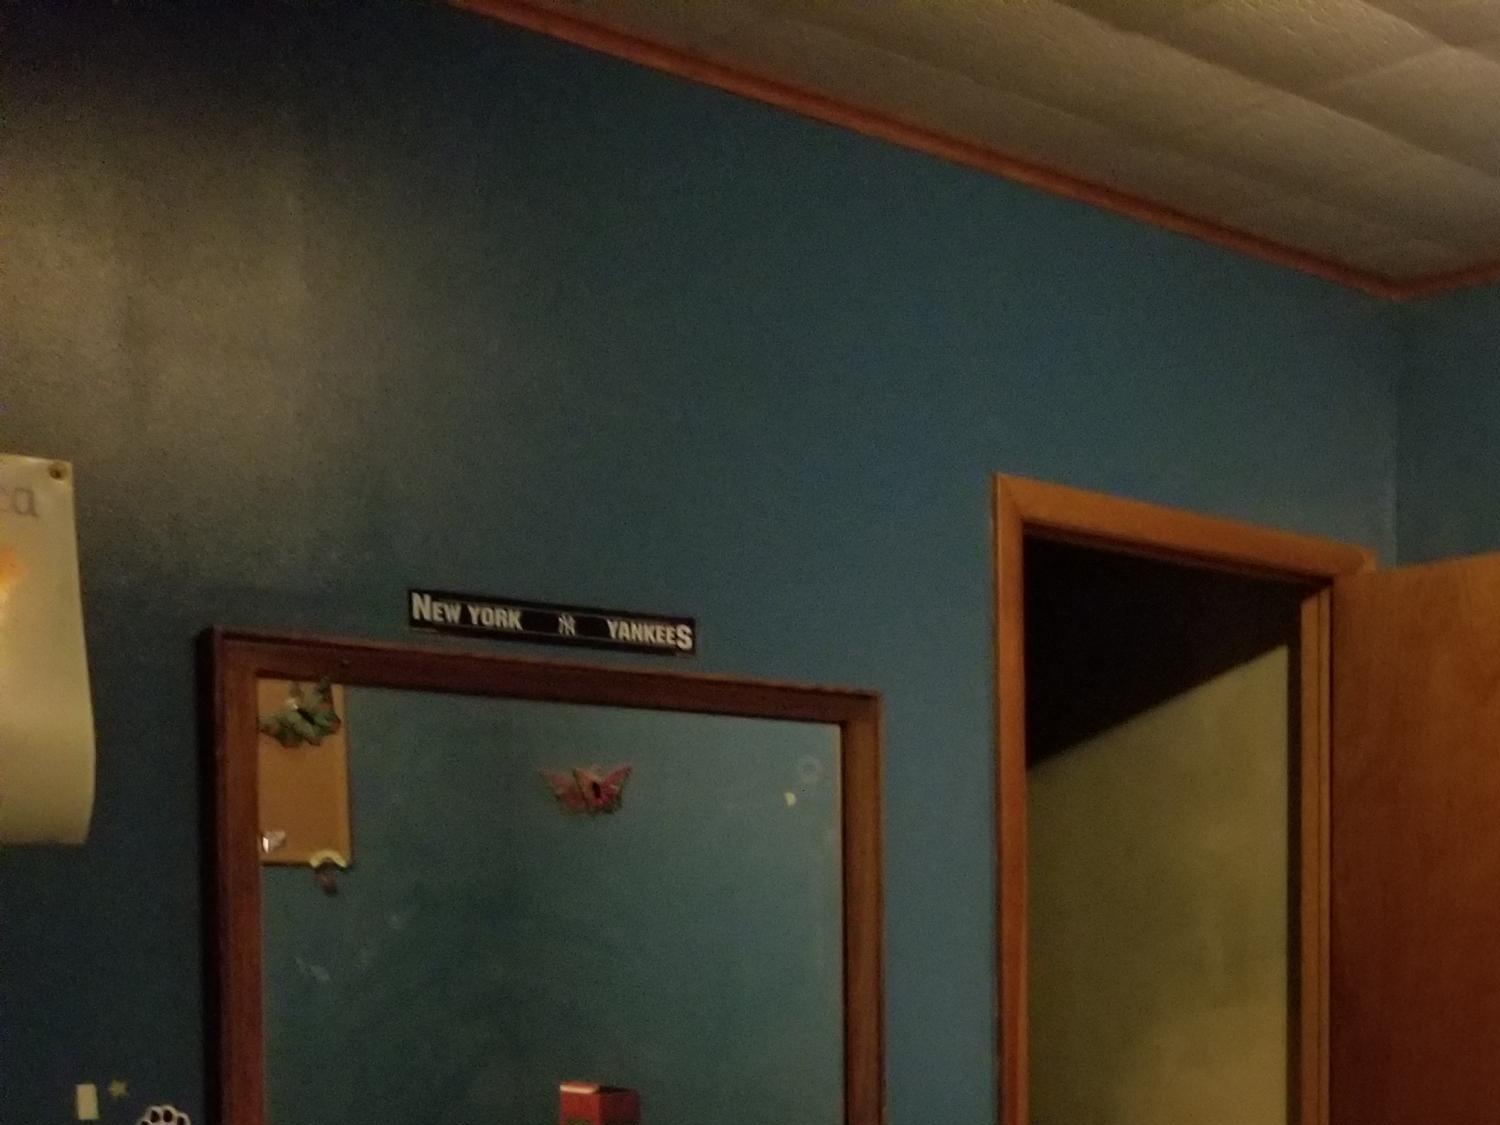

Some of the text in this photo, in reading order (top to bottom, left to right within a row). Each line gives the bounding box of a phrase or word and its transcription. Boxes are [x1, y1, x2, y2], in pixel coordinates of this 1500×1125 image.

[411, 592, 460, 624] NEW
[467, 604, 524, 631] YORK
[607, 619, 693, 650] YANKEES
